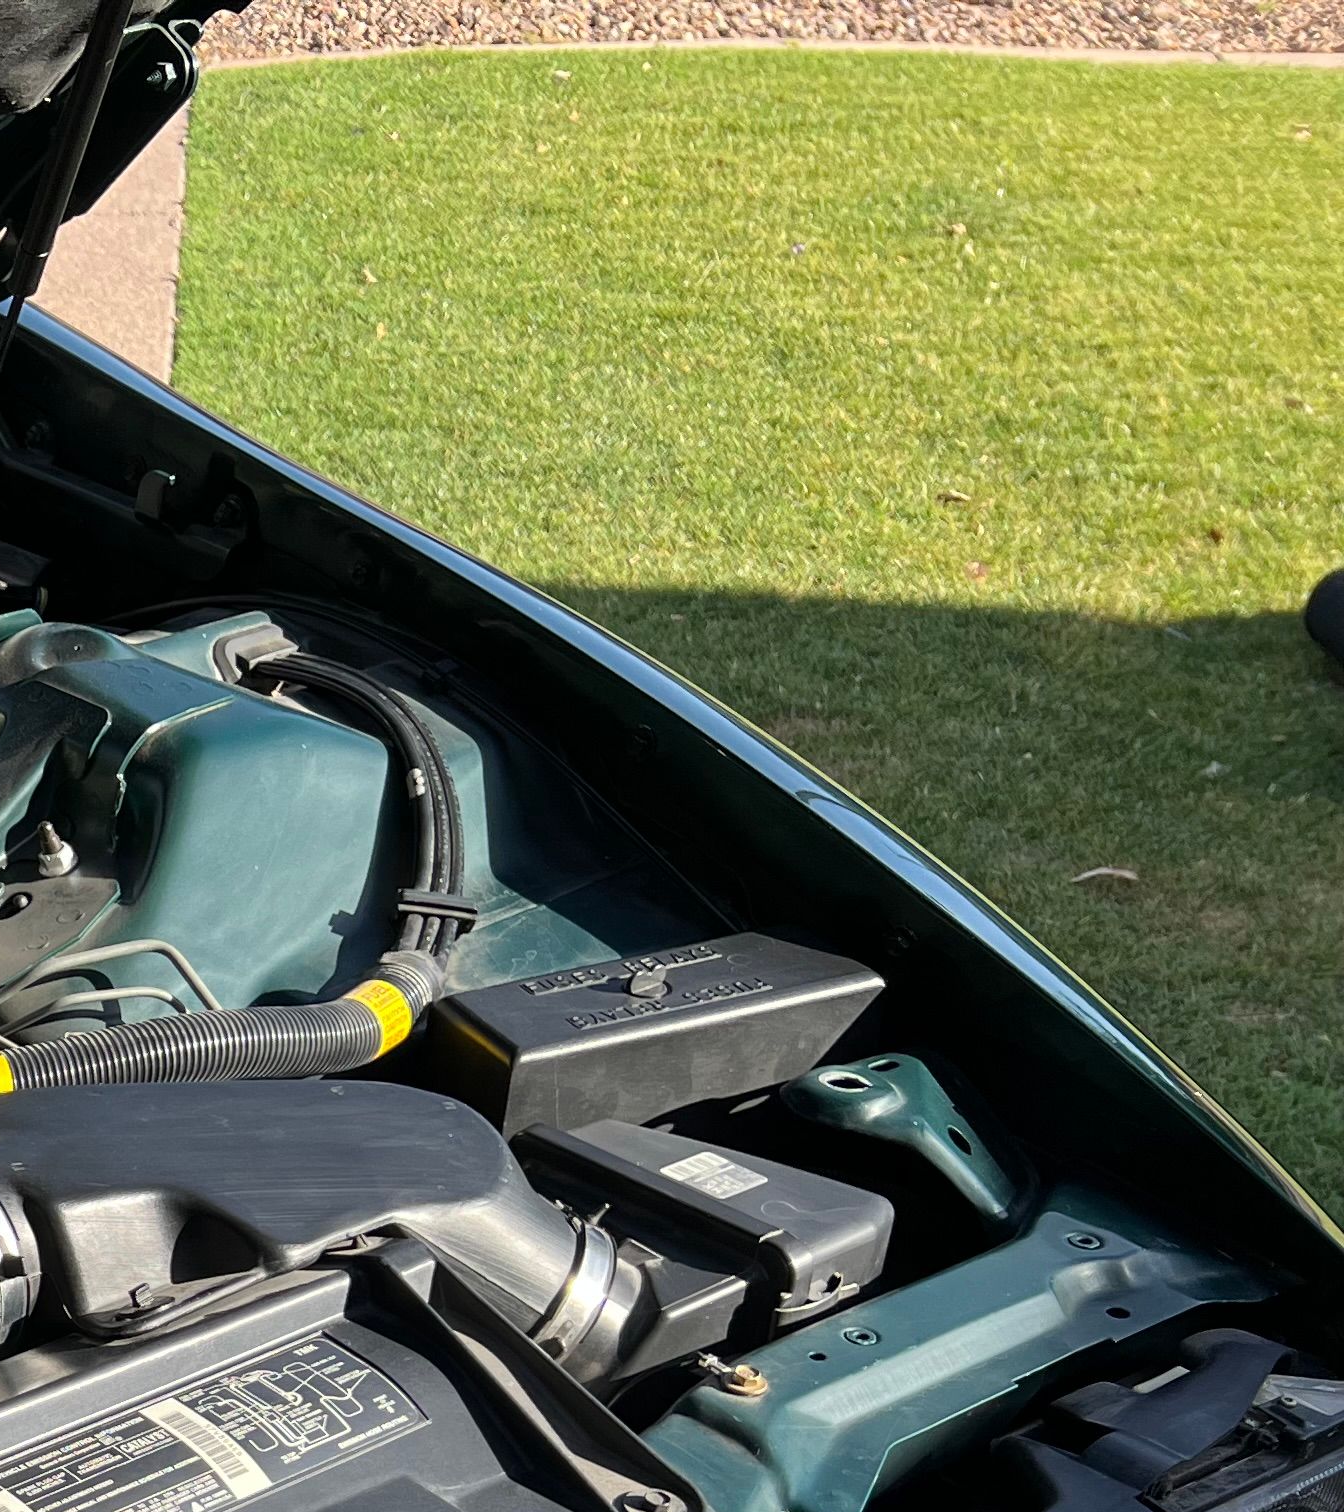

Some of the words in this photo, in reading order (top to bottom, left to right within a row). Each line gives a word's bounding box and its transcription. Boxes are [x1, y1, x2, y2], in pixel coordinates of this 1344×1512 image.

[520, 969, 608, 995] FUSES
[683, 978, 773, 1003] FUSES
[567, 1001, 669, 1030] RELAYS
[118, 1427, 172, 1454] CATALYST
